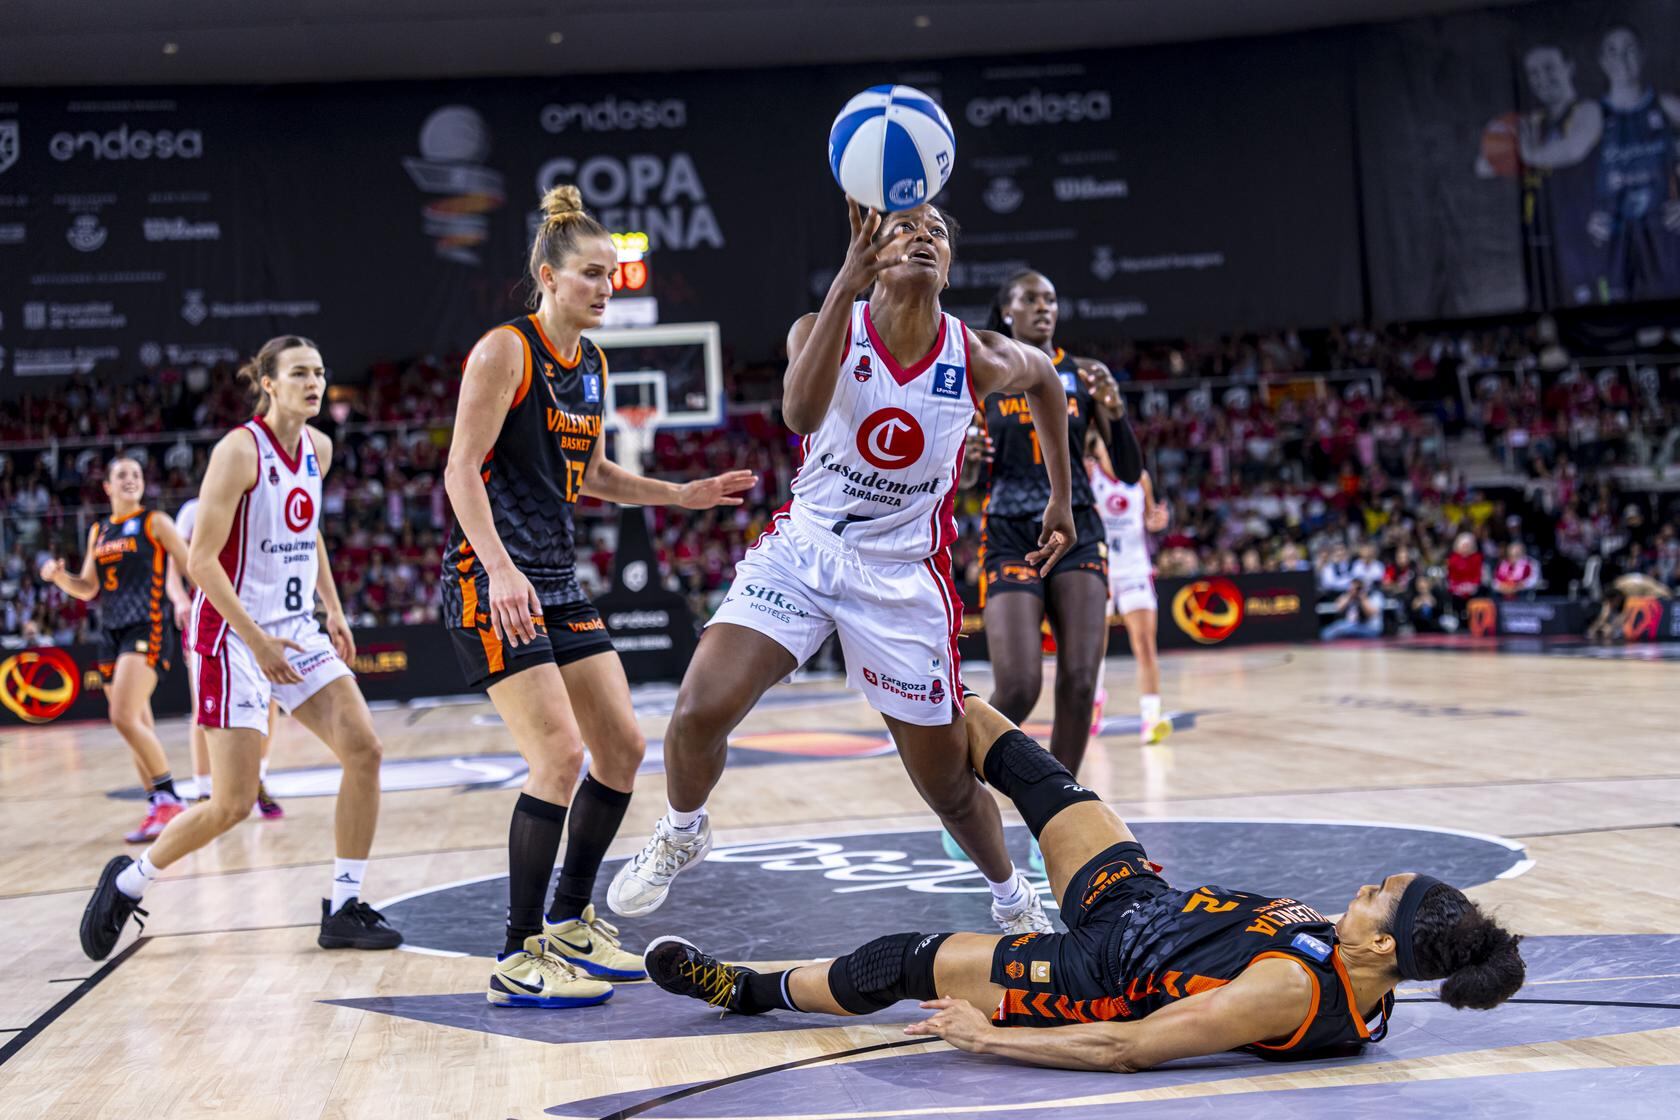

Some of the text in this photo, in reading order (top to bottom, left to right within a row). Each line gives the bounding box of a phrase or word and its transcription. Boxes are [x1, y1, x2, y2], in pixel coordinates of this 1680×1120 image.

[540, 97, 686, 133] endesa
[998, 397, 1079, 417] VALA
[561, 434, 592, 451] BASKET
[820, 453, 941, 496] Casademont
[842, 483, 902, 507] ZARAGOZA
[104, 566, 119, 592] 5
[285, 576, 302, 612] 8
[750, 602, 791, 624] HOTELES
[880, 673, 927, 691] Zaragoza
